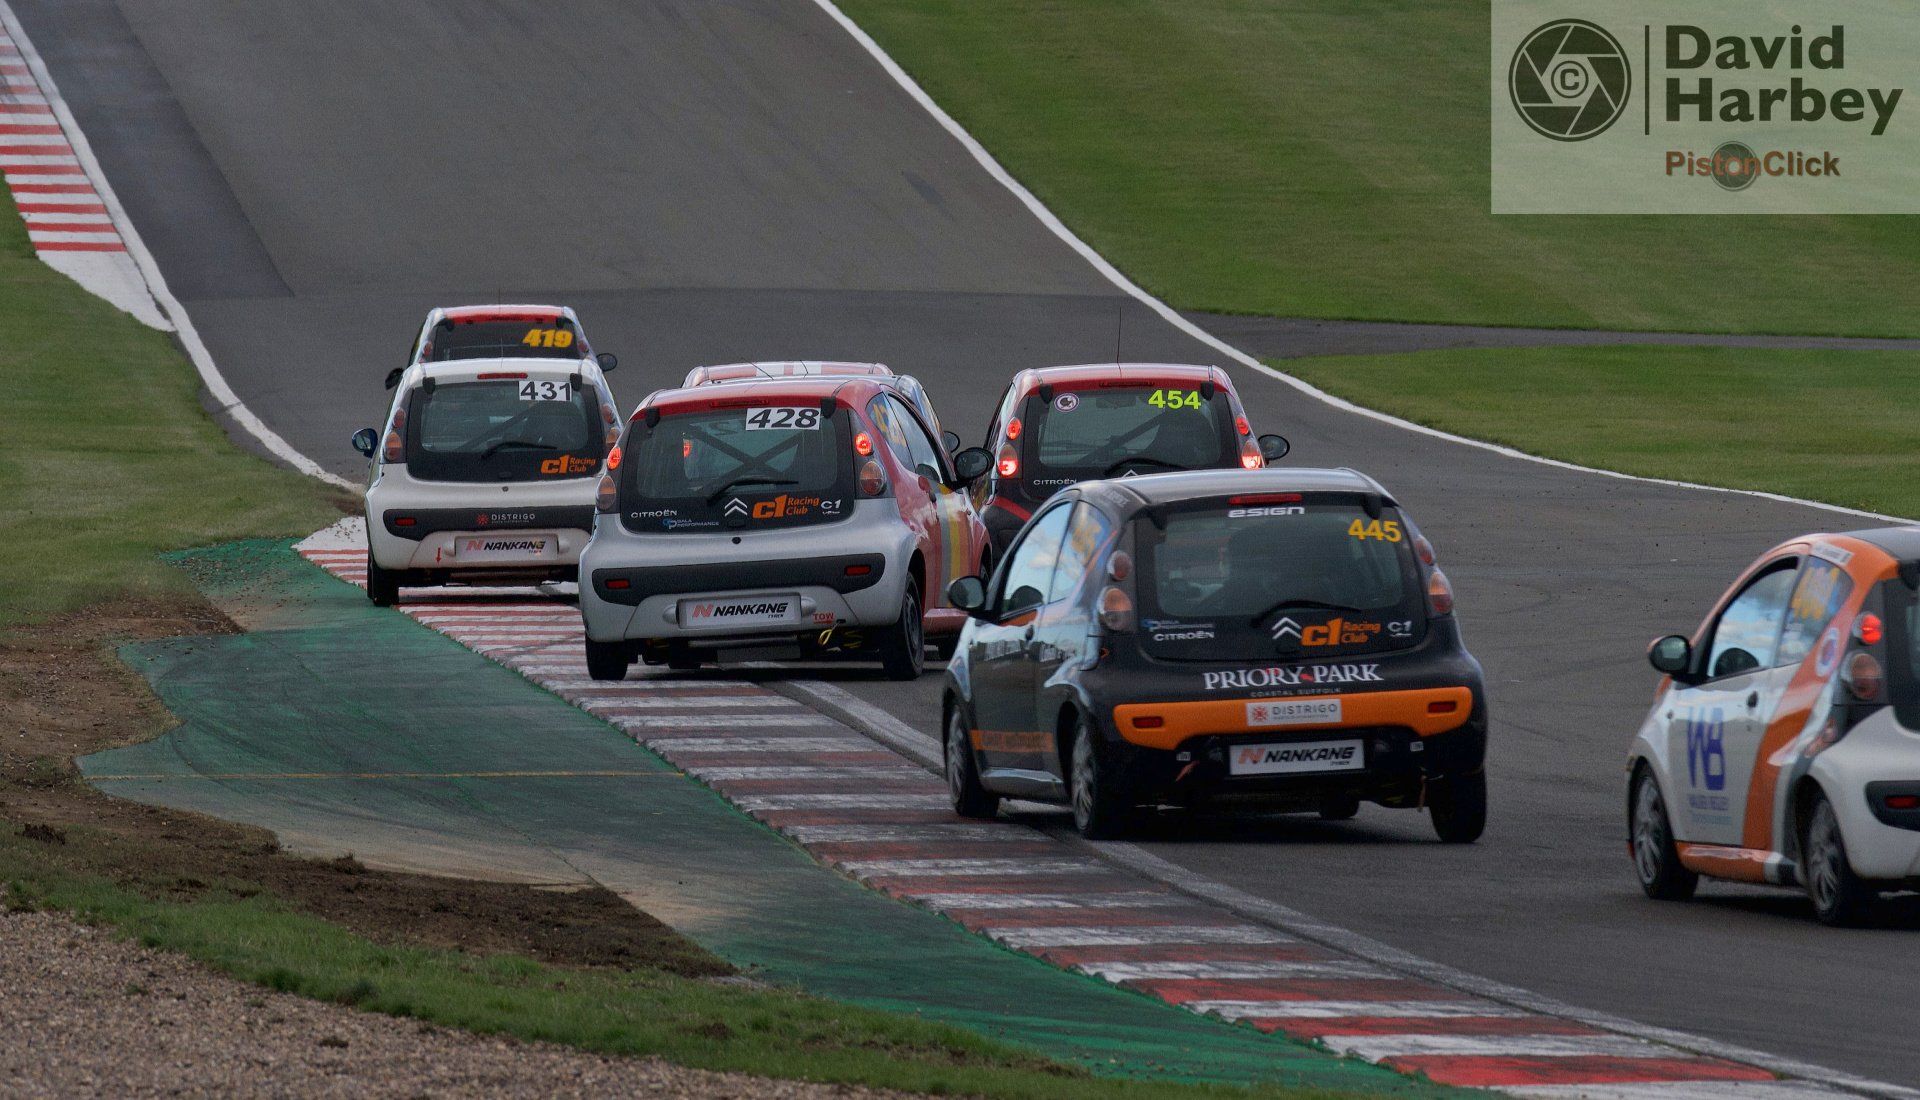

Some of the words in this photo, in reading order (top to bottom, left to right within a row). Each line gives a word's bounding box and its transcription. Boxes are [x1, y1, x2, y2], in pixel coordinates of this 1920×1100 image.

[522, 329, 573, 348] 419
[520, 381, 571, 401] 431
[1148, 389, 1202, 410] 454
[747, 408, 820, 429] 428
[570, 457, 596, 465] Racing
[569, 464, 587, 473] Club
[787, 496, 820, 507] Racing
[820, 499, 842, 509] C1
[491, 513, 536, 521] DISTRIGO
[630, 509, 678, 519] CITROËN
[786, 506, 809, 516] Club
[1348, 518, 1402, 543] 445
[484, 541, 546, 551] NANKANG
[713, 602, 788, 617] NANKANG
[813, 612, 834, 621] TOW
[1343, 621, 1381, 633] Racing
[1387, 620, 1412, 633] C1
[1341, 633, 1368, 643] Club
[1202, 666, 1305, 691] PRIORY
[1311, 663, 1385, 684] PARK
[1250, 690, 1293, 698] COASTAL
[1271, 702, 1338, 716] DISTRIGO
[1687, 705, 1726, 791] WB
[1264, 746, 1356, 764] NANKANG
